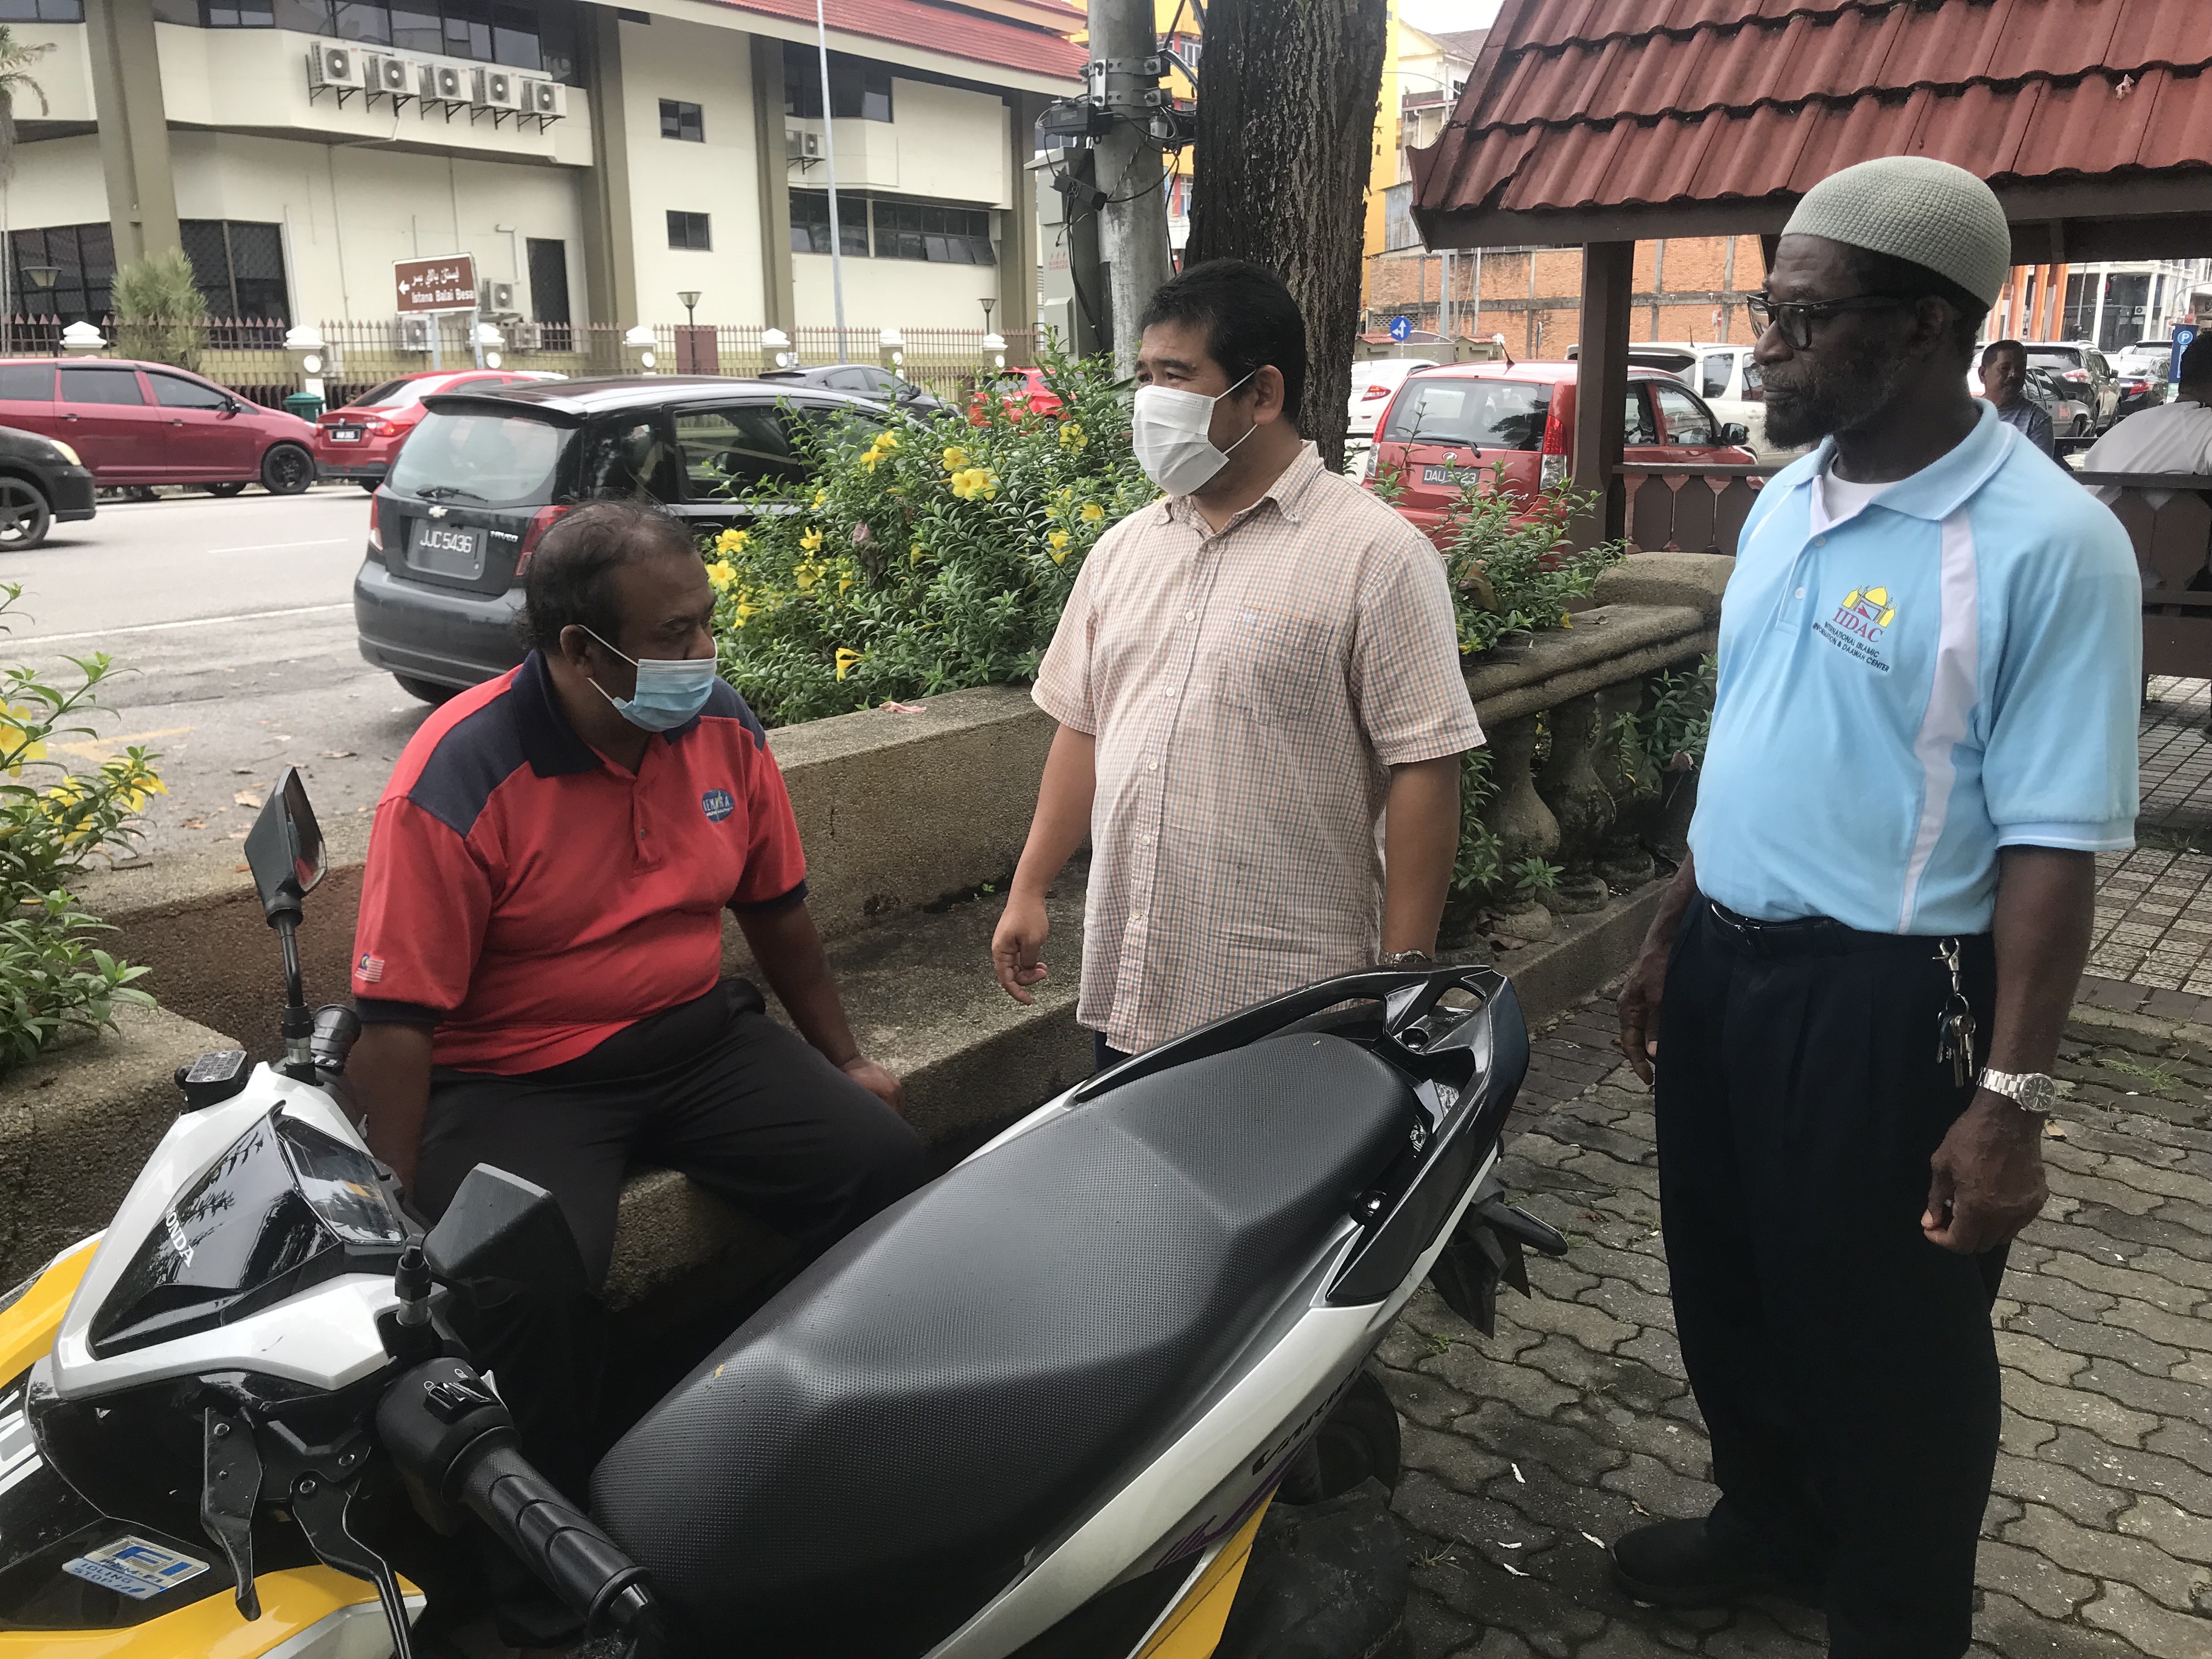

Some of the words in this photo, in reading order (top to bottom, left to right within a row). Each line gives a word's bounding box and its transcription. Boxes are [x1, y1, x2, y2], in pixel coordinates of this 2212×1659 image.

[411, 292, 433, 303] Istana
[435, 289, 454, 302] Balai
[455, 288, 475, 301] Besa
[2181, 333, 2190, 342] P
[1832, 607, 1884, 643] IIDAC
[1813, 622, 1837, 645] INFORMATION
[1842, 644, 1866, 661] DAAWAH
[1866, 657, 1889, 673] CENTER
[1824, 622, 1855, 646] INTERNATIONAL
[1856, 642, 1880, 658] ISLAMIC
[166, 1203, 194, 1268] HONDA
[72, 1567, 113, 1583] STOP
[81, 1563, 133, 1584] IDLING
